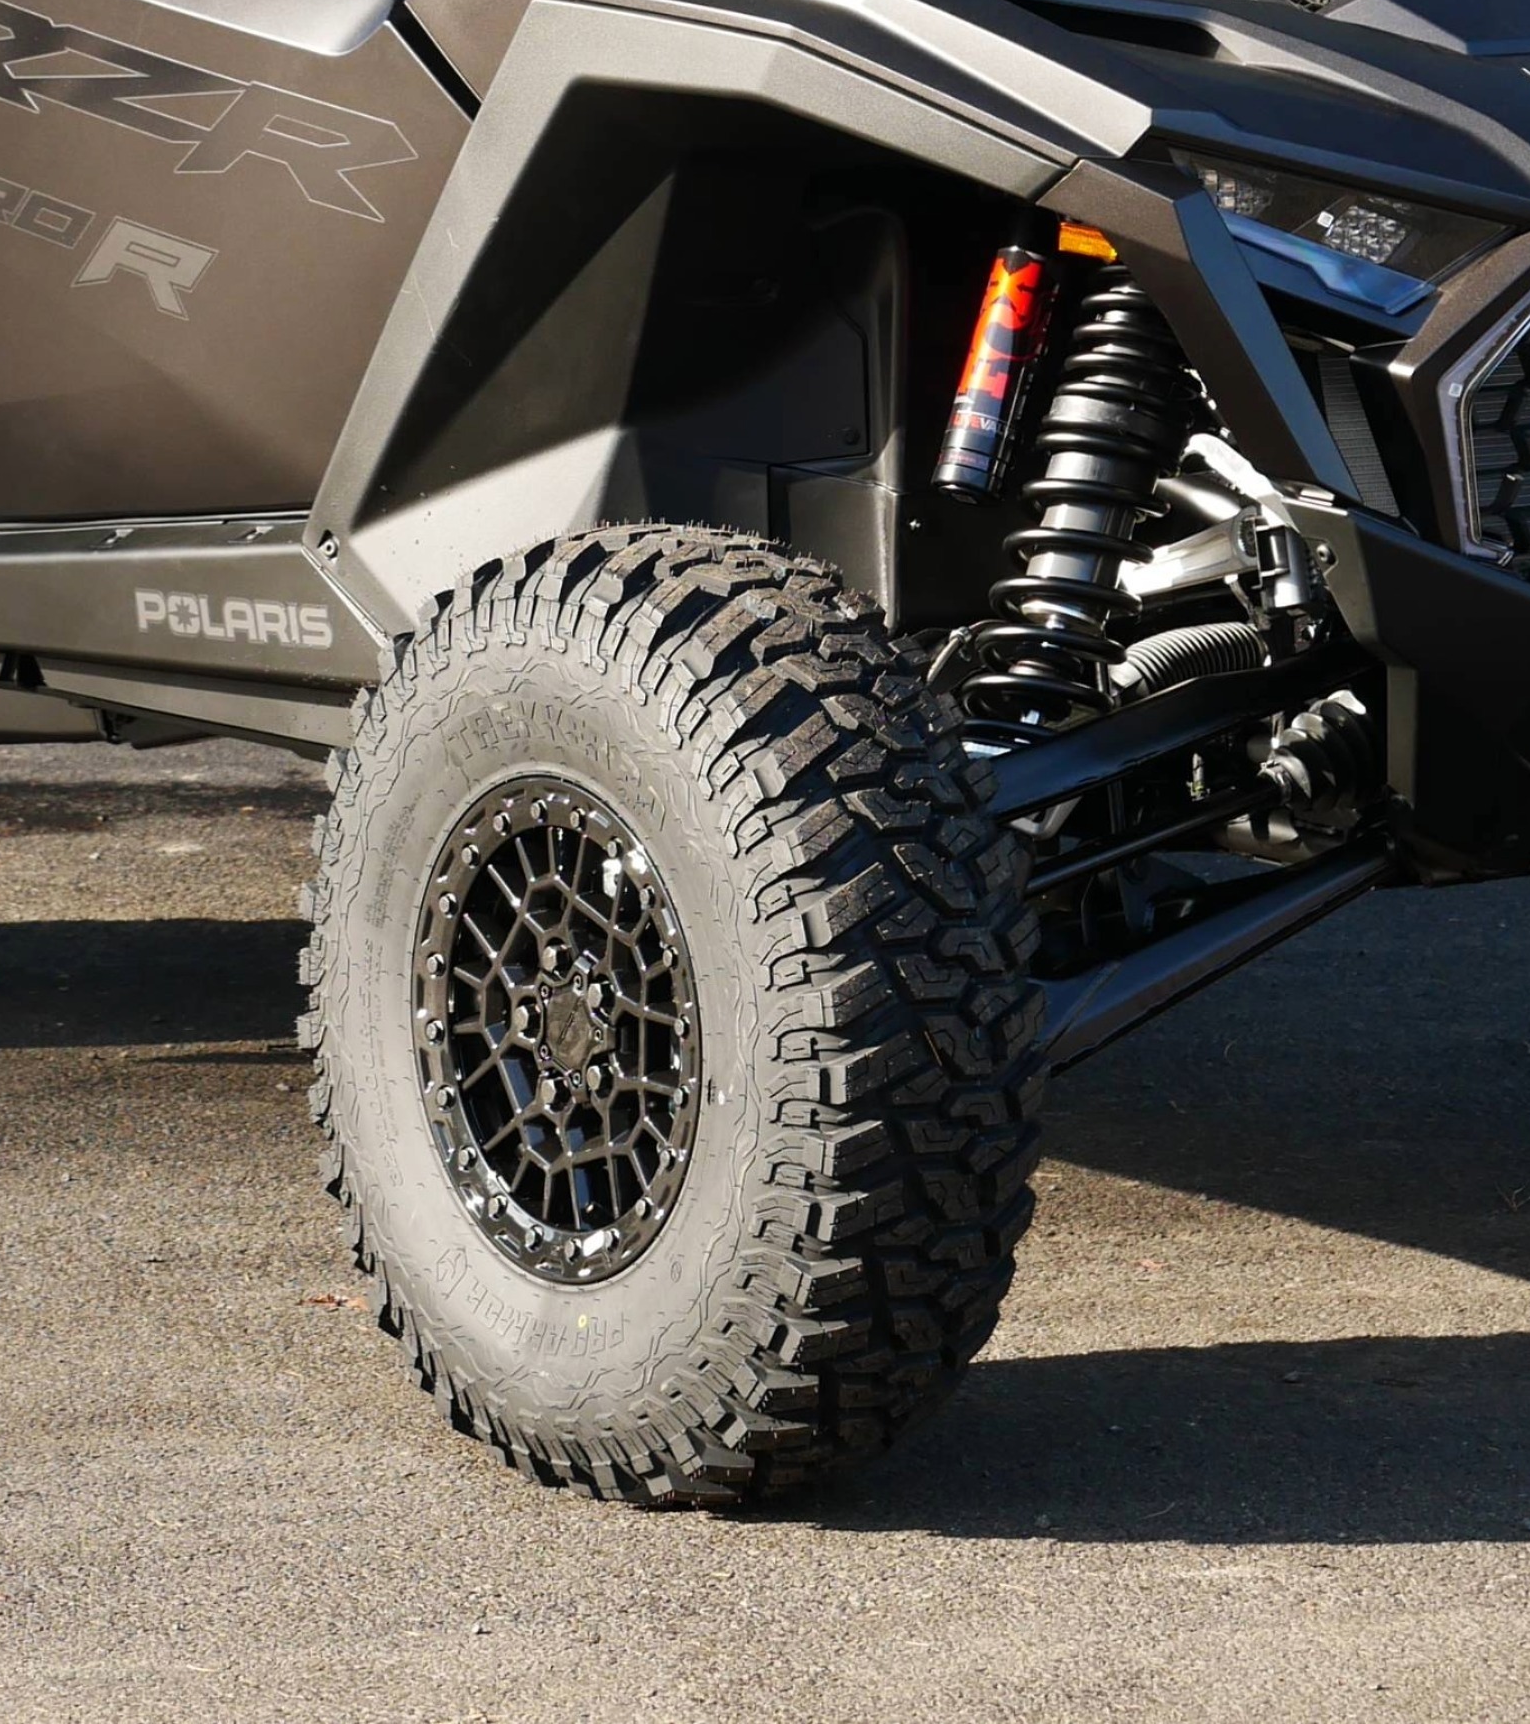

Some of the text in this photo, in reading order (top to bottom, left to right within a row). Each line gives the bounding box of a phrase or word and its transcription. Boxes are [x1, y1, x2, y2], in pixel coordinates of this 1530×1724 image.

[71, 216, 219, 320] R
[957, 257, 1047, 399] FOX
[134, 587, 334, 649] POLARIS
